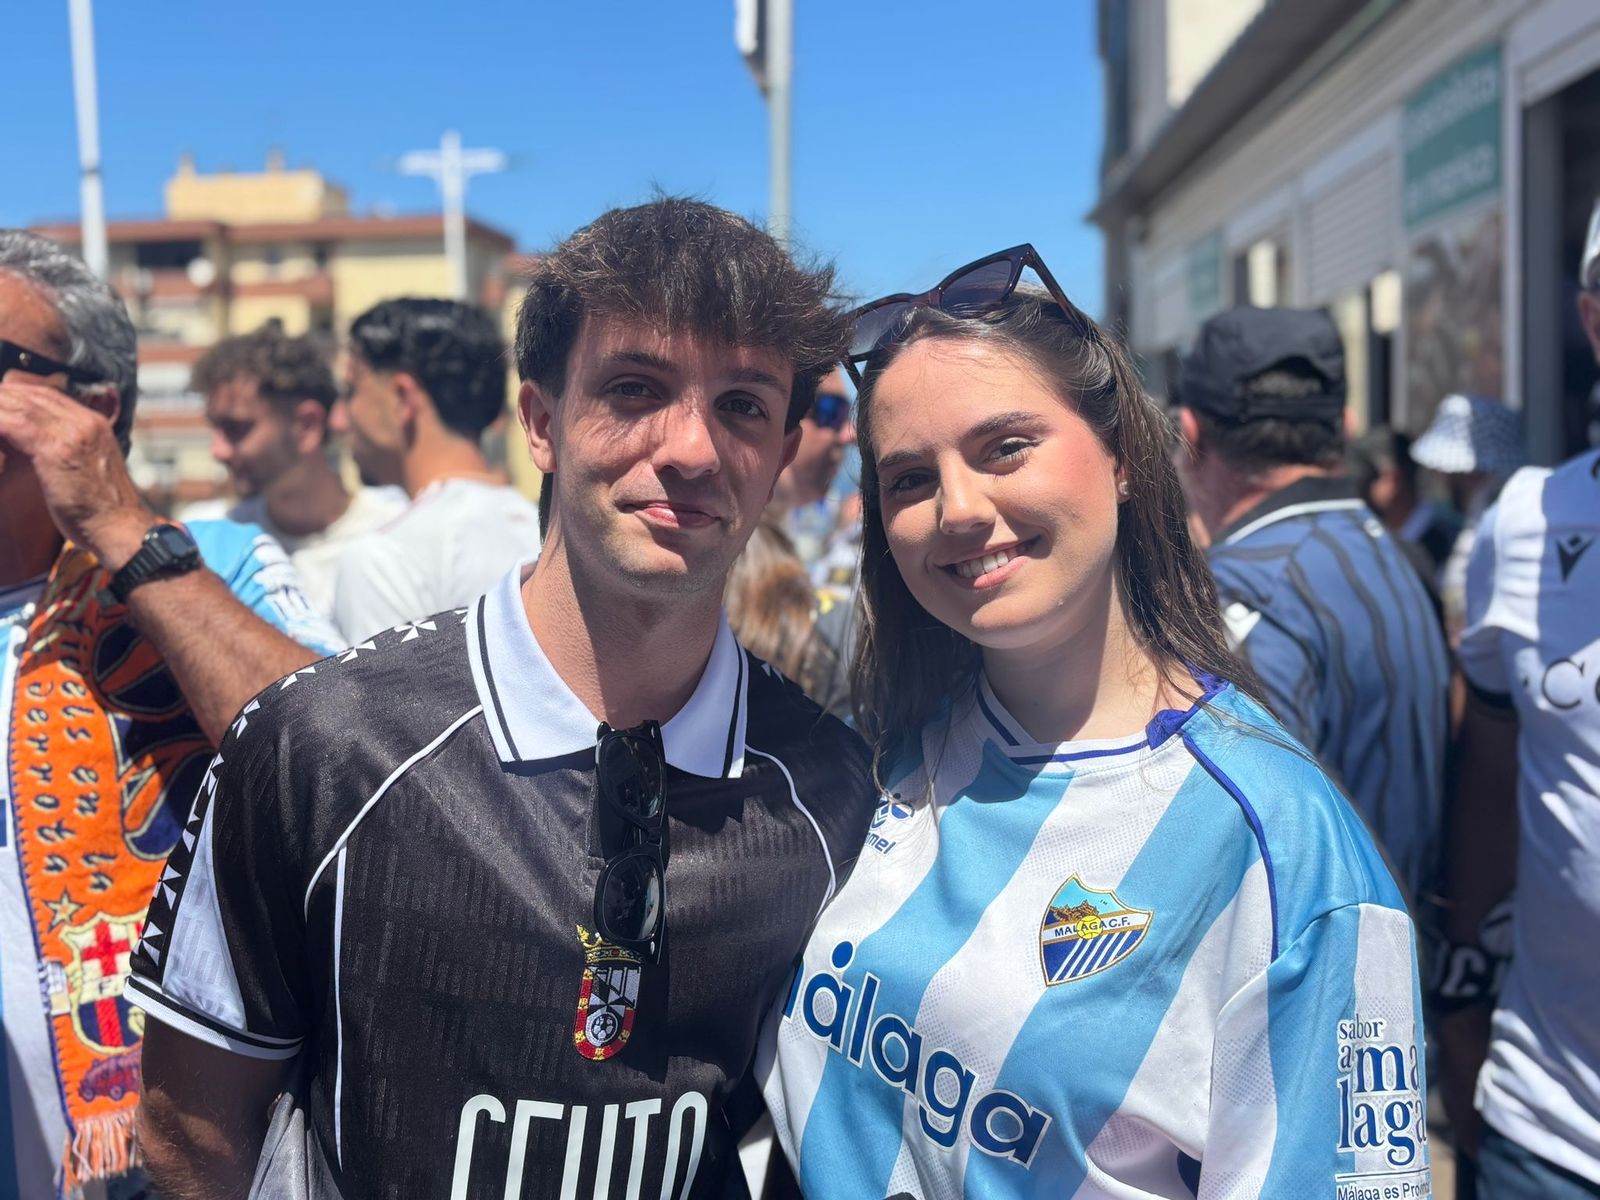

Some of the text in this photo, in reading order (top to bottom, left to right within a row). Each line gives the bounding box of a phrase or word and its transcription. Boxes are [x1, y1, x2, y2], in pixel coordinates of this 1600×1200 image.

[866, 832, 897, 855] mel
[1055, 921, 1107, 937] MALAGA
[1339, 1014, 1383, 1041] sabor
[782, 940, 1052, 1169] álaga
[1384, 1186, 1400, 1199] es
